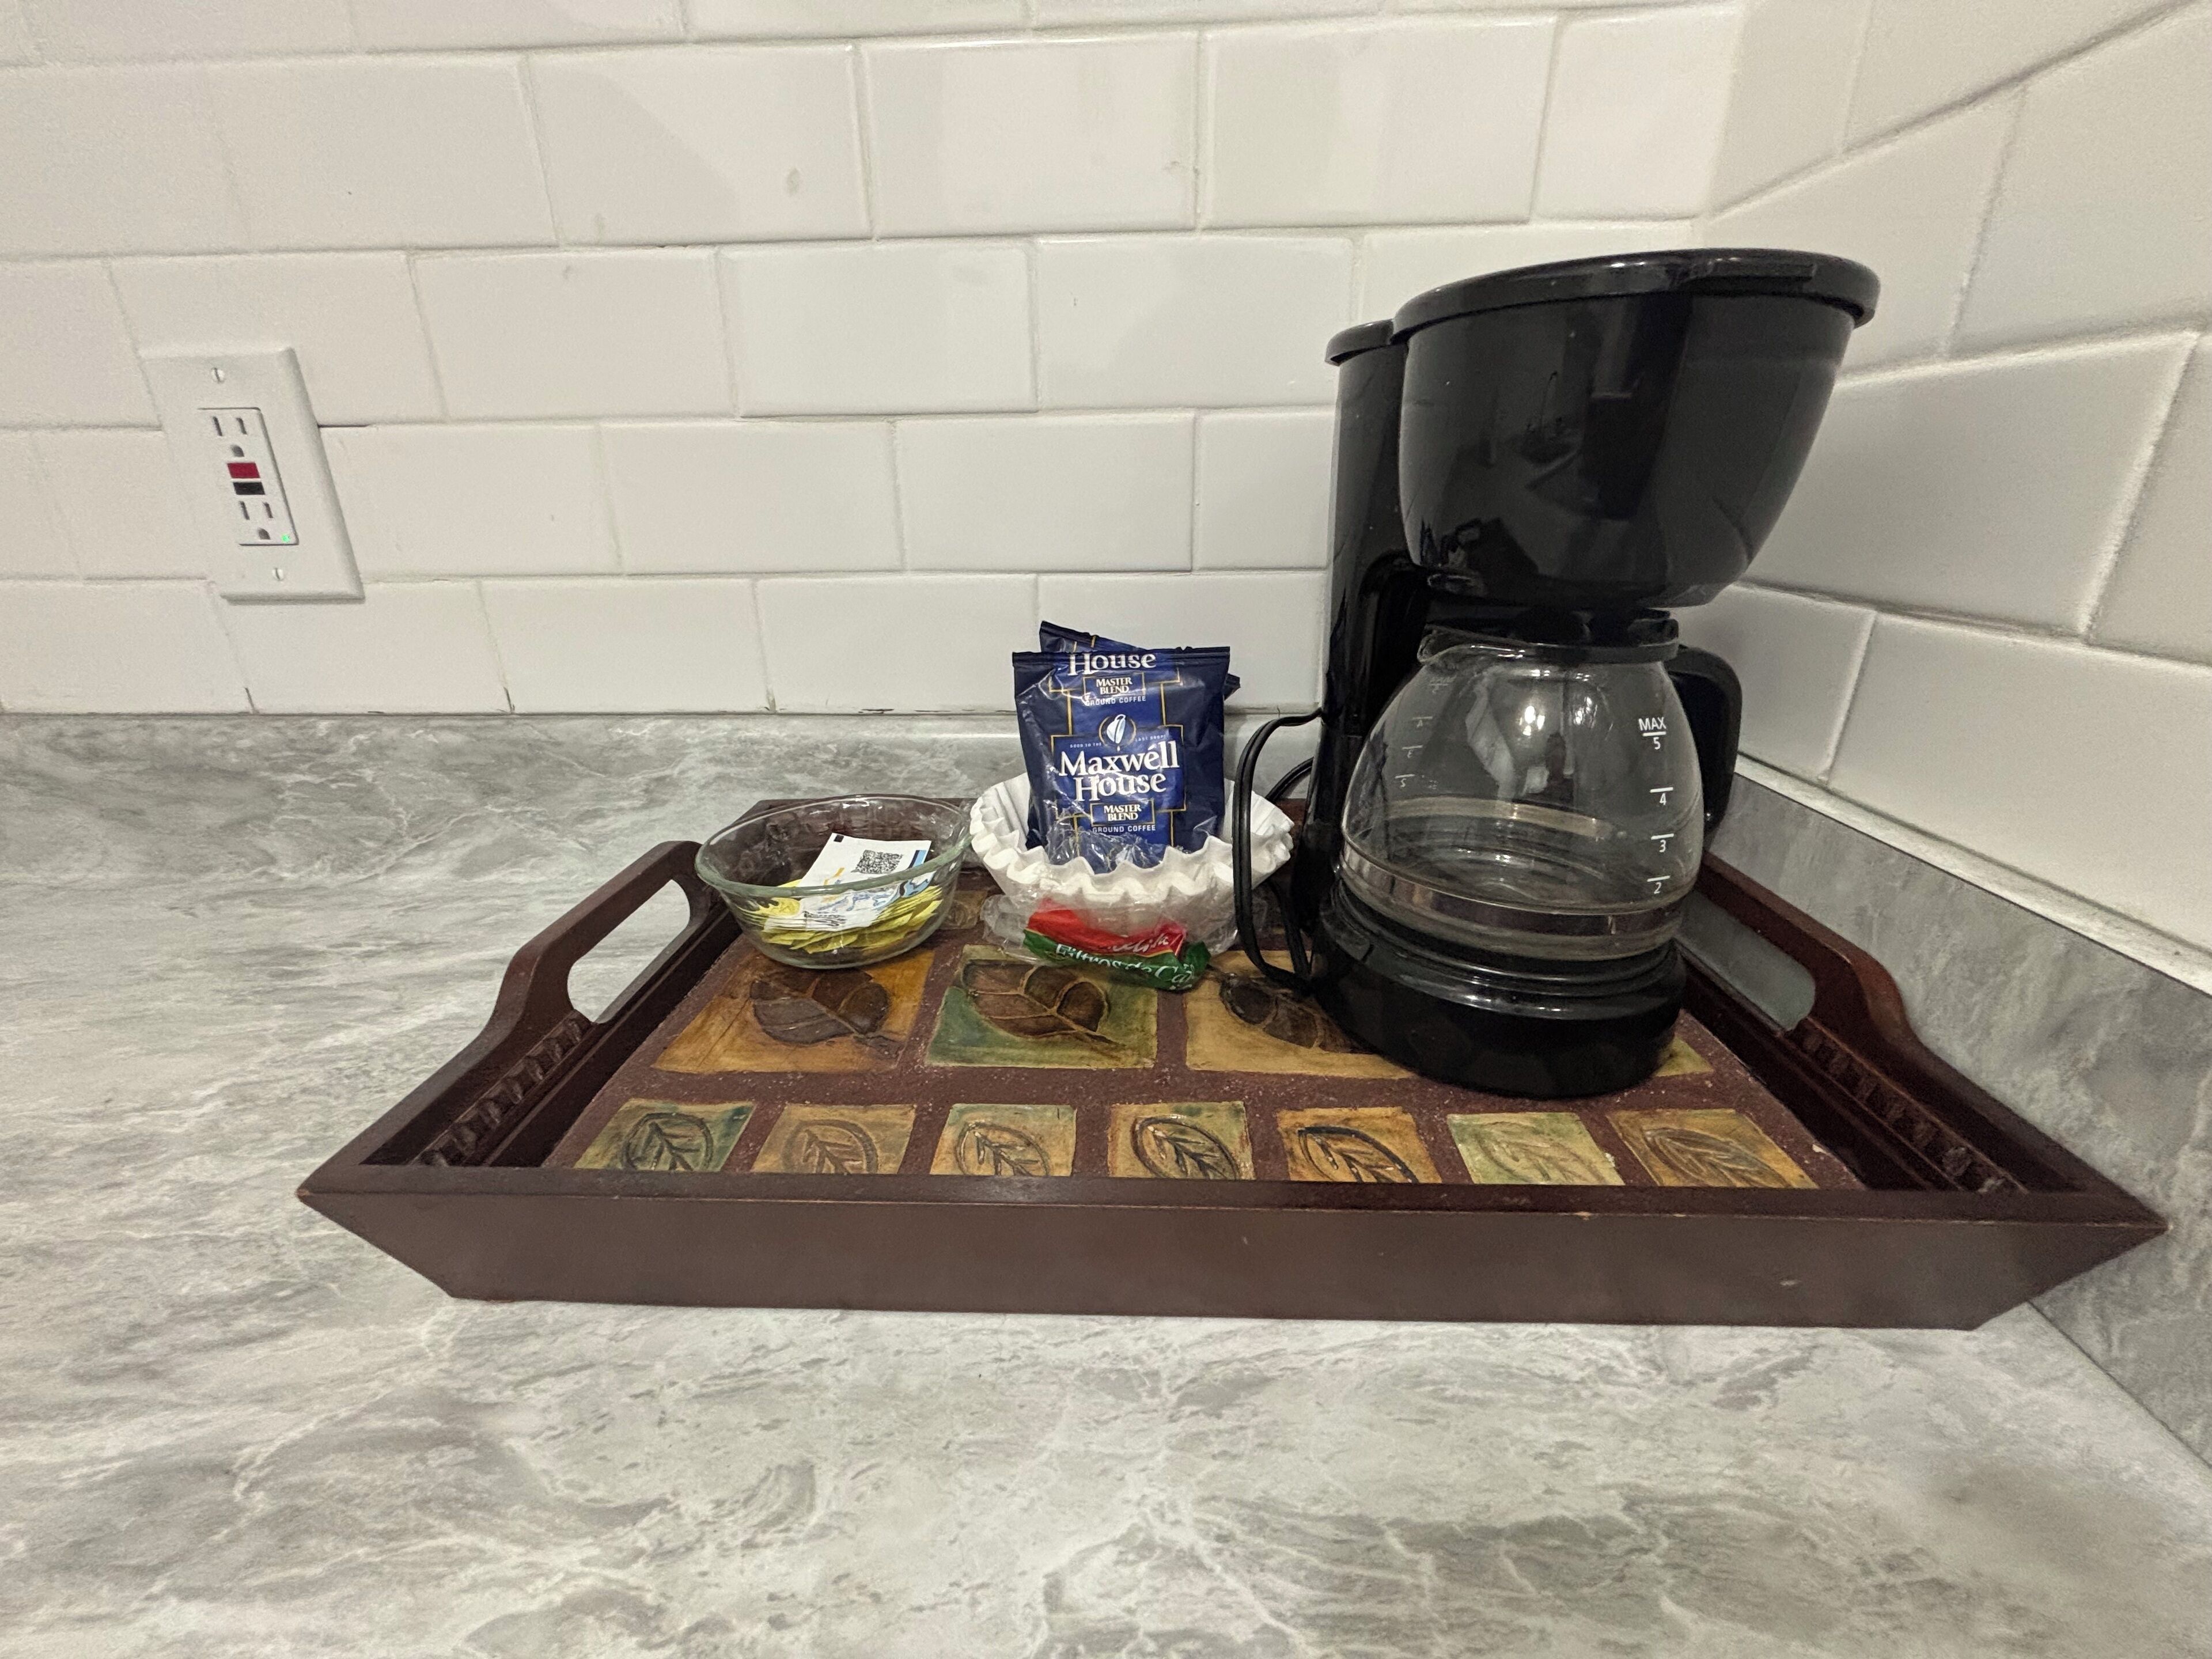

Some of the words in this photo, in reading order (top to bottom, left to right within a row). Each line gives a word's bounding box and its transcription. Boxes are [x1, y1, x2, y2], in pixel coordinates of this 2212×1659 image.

[1067, 653, 1157, 676] House
[1096, 676, 1133, 687] MASTER
[1100, 685, 1130, 695] BLEND
[1086, 698, 1116, 706] GROUND
[1119, 695, 1146, 704] COFFEE
[1638, 716, 1666, 731] MAX
[1653, 736, 1661, 750] 5
[1058, 740, 1180, 777] Maxwell
[1073, 772, 1167, 802] House
[1659, 793, 1666, 806] 4
[1103, 804, 1142, 813] MASTER
[1107, 812, 1139, 821] BLEND
[1659, 839, 1666, 853] 3
[1653, 881, 1662, 895] 2
